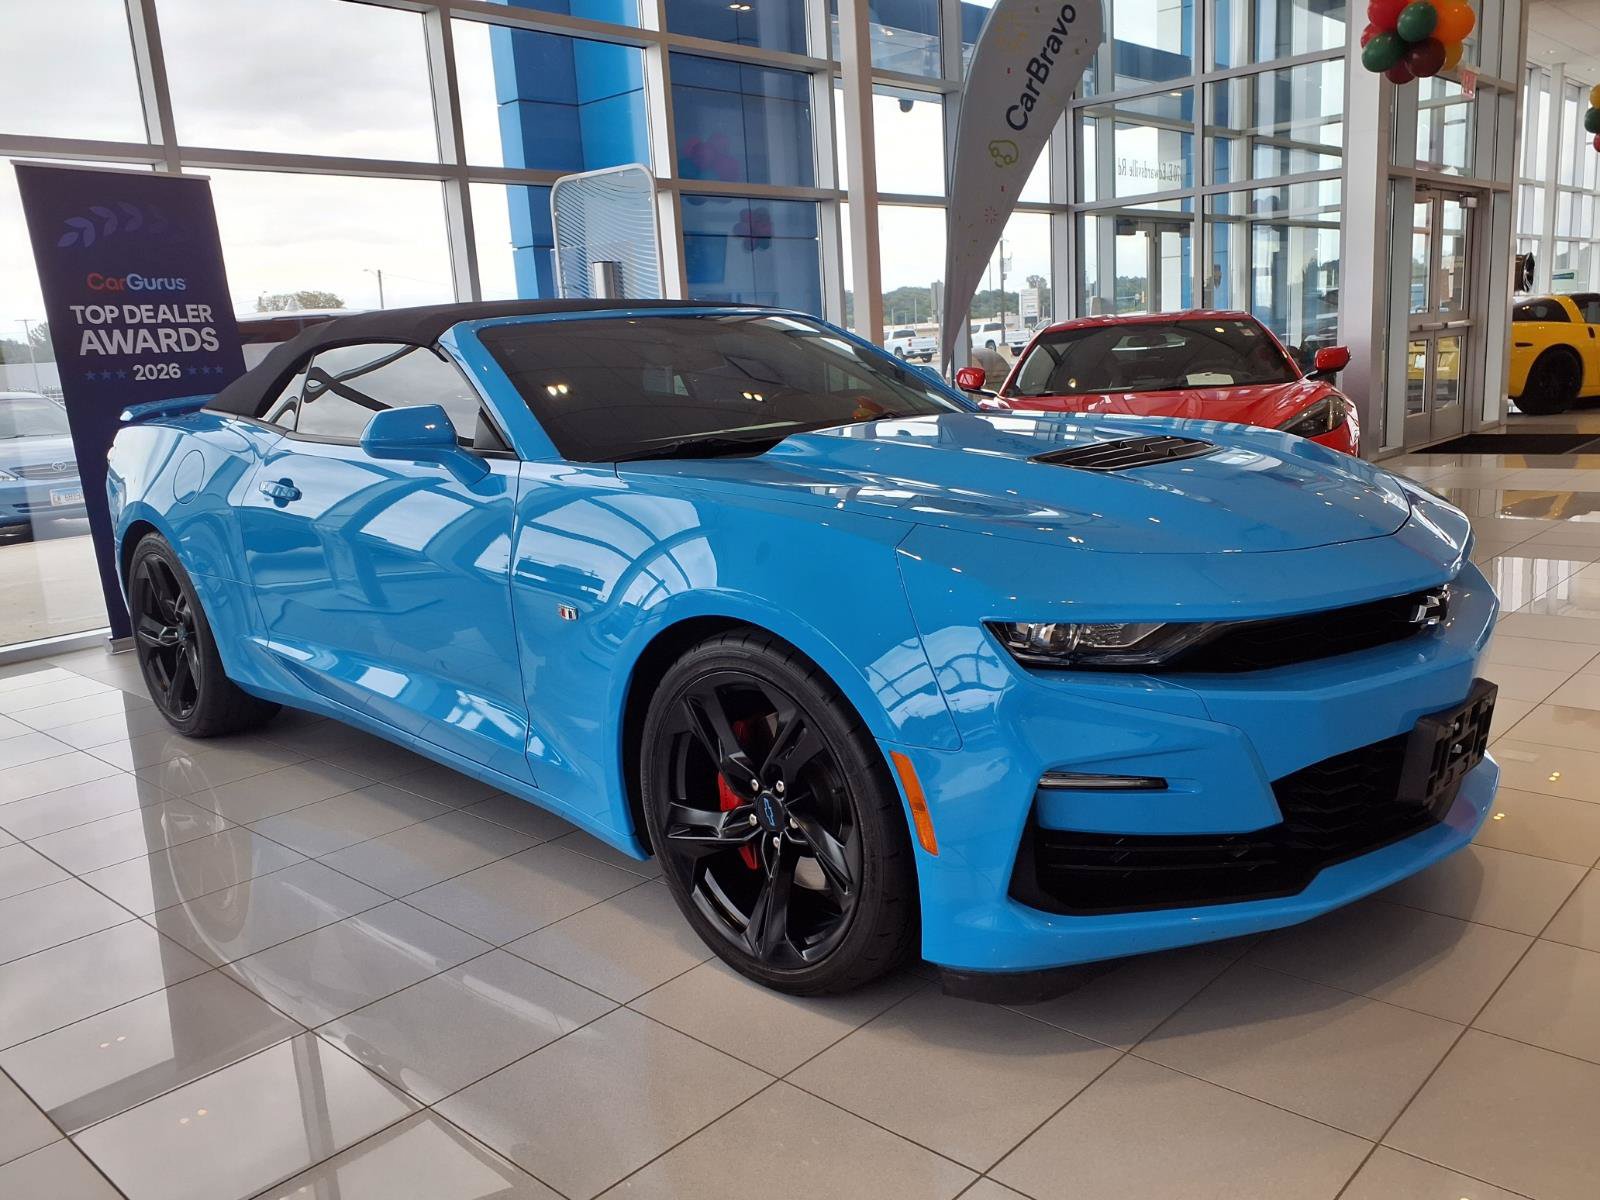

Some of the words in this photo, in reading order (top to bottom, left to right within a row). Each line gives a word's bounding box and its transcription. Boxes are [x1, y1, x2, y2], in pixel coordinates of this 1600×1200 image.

[1006, 4, 1076, 131] CarBravo
[86, 272, 187, 291] CarGurus
[69, 304, 119, 325] TOP
[122, 304, 214, 324] DEALER
[79, 326, 220, 356] AWARDS
[132, 363, 182, 381] 2026
